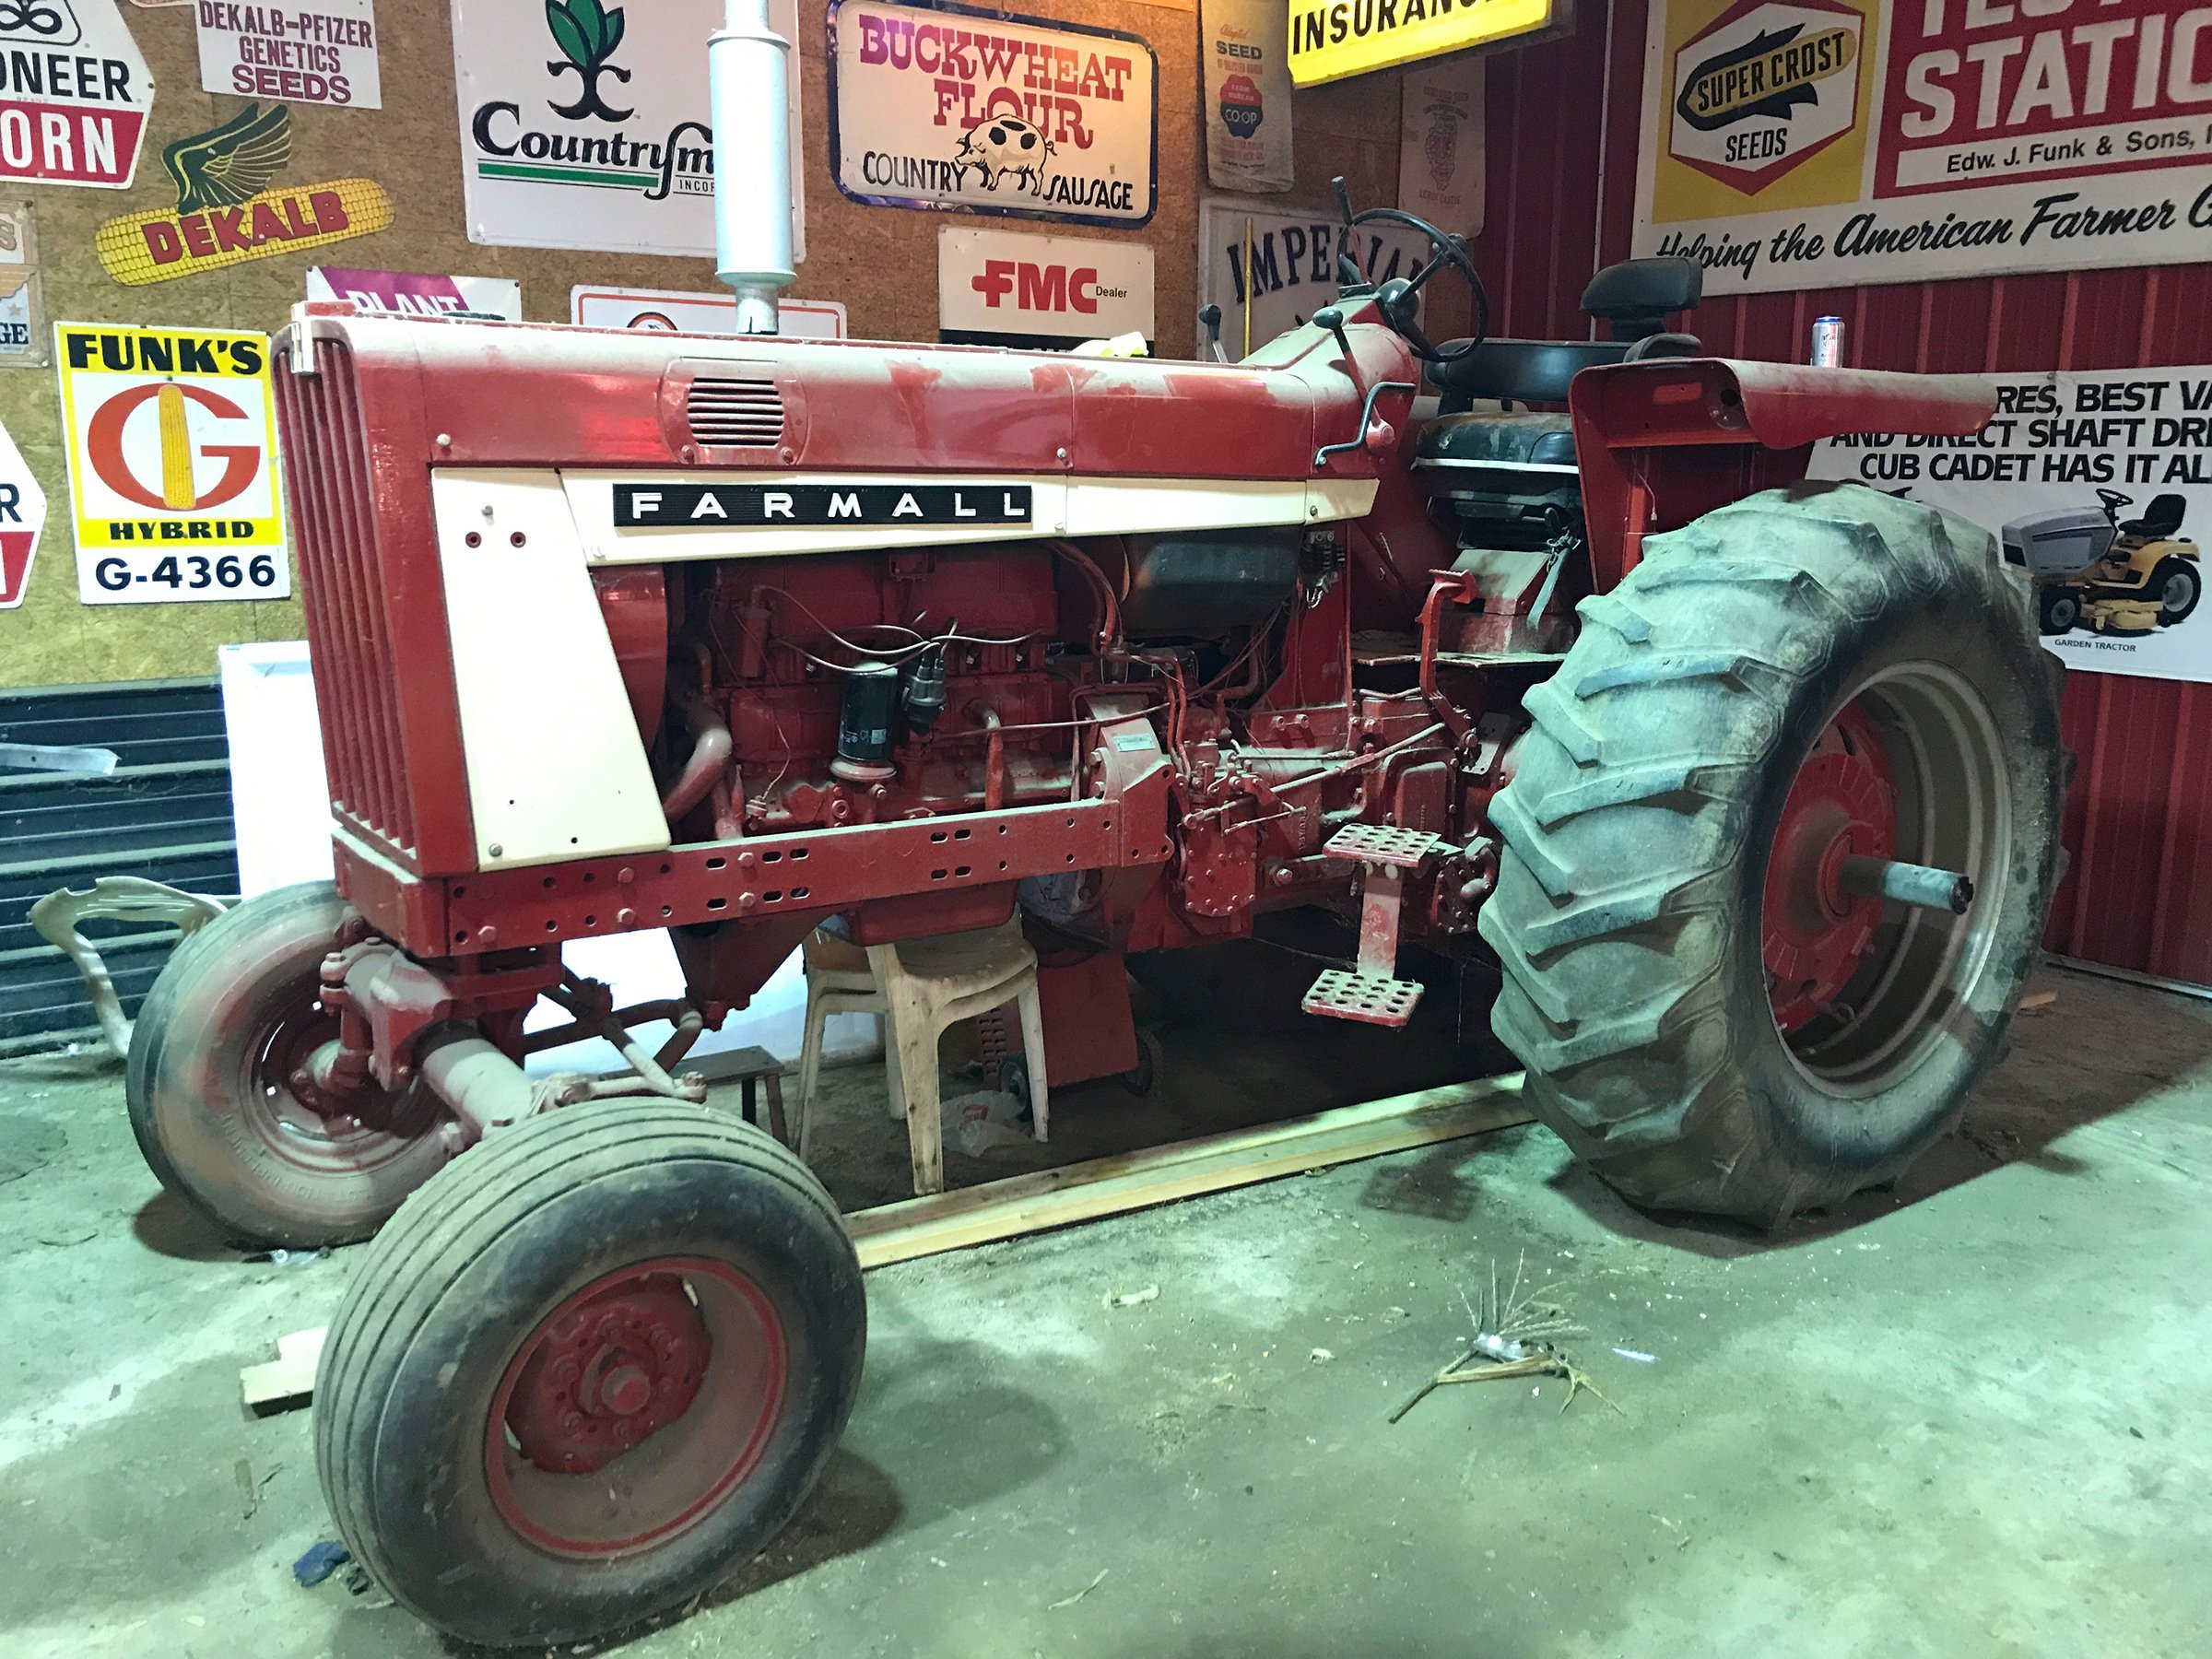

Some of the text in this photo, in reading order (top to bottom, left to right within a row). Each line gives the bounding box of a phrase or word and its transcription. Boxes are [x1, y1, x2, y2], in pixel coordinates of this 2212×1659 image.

[199, 1, 372, 48] DEKALB-PFIZER
[1292, 0, 1491, 55] INSURA
[239, 36, 341, 74] GENETICS
[859, 14, 1132, 101] BUCKWHEAT
[1216, 41, 1263, 60] SEED
[1697, 31, 1844, 112] SUPER CROST
[0, 49, 133, 102] NEER
[232, 65, 351, 104] SEEDS
[934, 79, 1093, 149] FLOUR
[1725, 127, 1788, 162] SEEDS
[1947, 153, 1995, 173] Edw.
[2004, 147, 2021, 167] J.
[2029, 138, 2086, 163] Funk
[2096, 135, 2112, 156] &
[2125, 130, 2194, 152] Sons,
[864, 151, 1133, 210] COUNTRY SAUSAGE
[140, 191, 349, 265] DEKALB
[1770, 223, 1825, 263] the
[1833, 213, 2013, 258] American
[2020, 192, 2176, 246] Farmer
[1227, 224, 1424, 303] IMPEIA
[971, 259, 1127, 313] FMC Dealer
[66, 333, 263, 375] FUNK'S
[2076, 382, 2170, 412] BEST
[2029, 418, 2146, 448] SHAFT
[1860, 453, 1920, 480] CUB
[1929, 453, 2036, 482] CADET
[2041, 453, 2114, 483] HAS
[2125, 454, 2159, 484] IT
[631, 492, 1025, 519] FARMALL
[110, 521, 254, 540] HYBRID
[95, 555, 276, 591] G-4366
[2054, 639, 2136, 653] GARDEN TRACTOR
